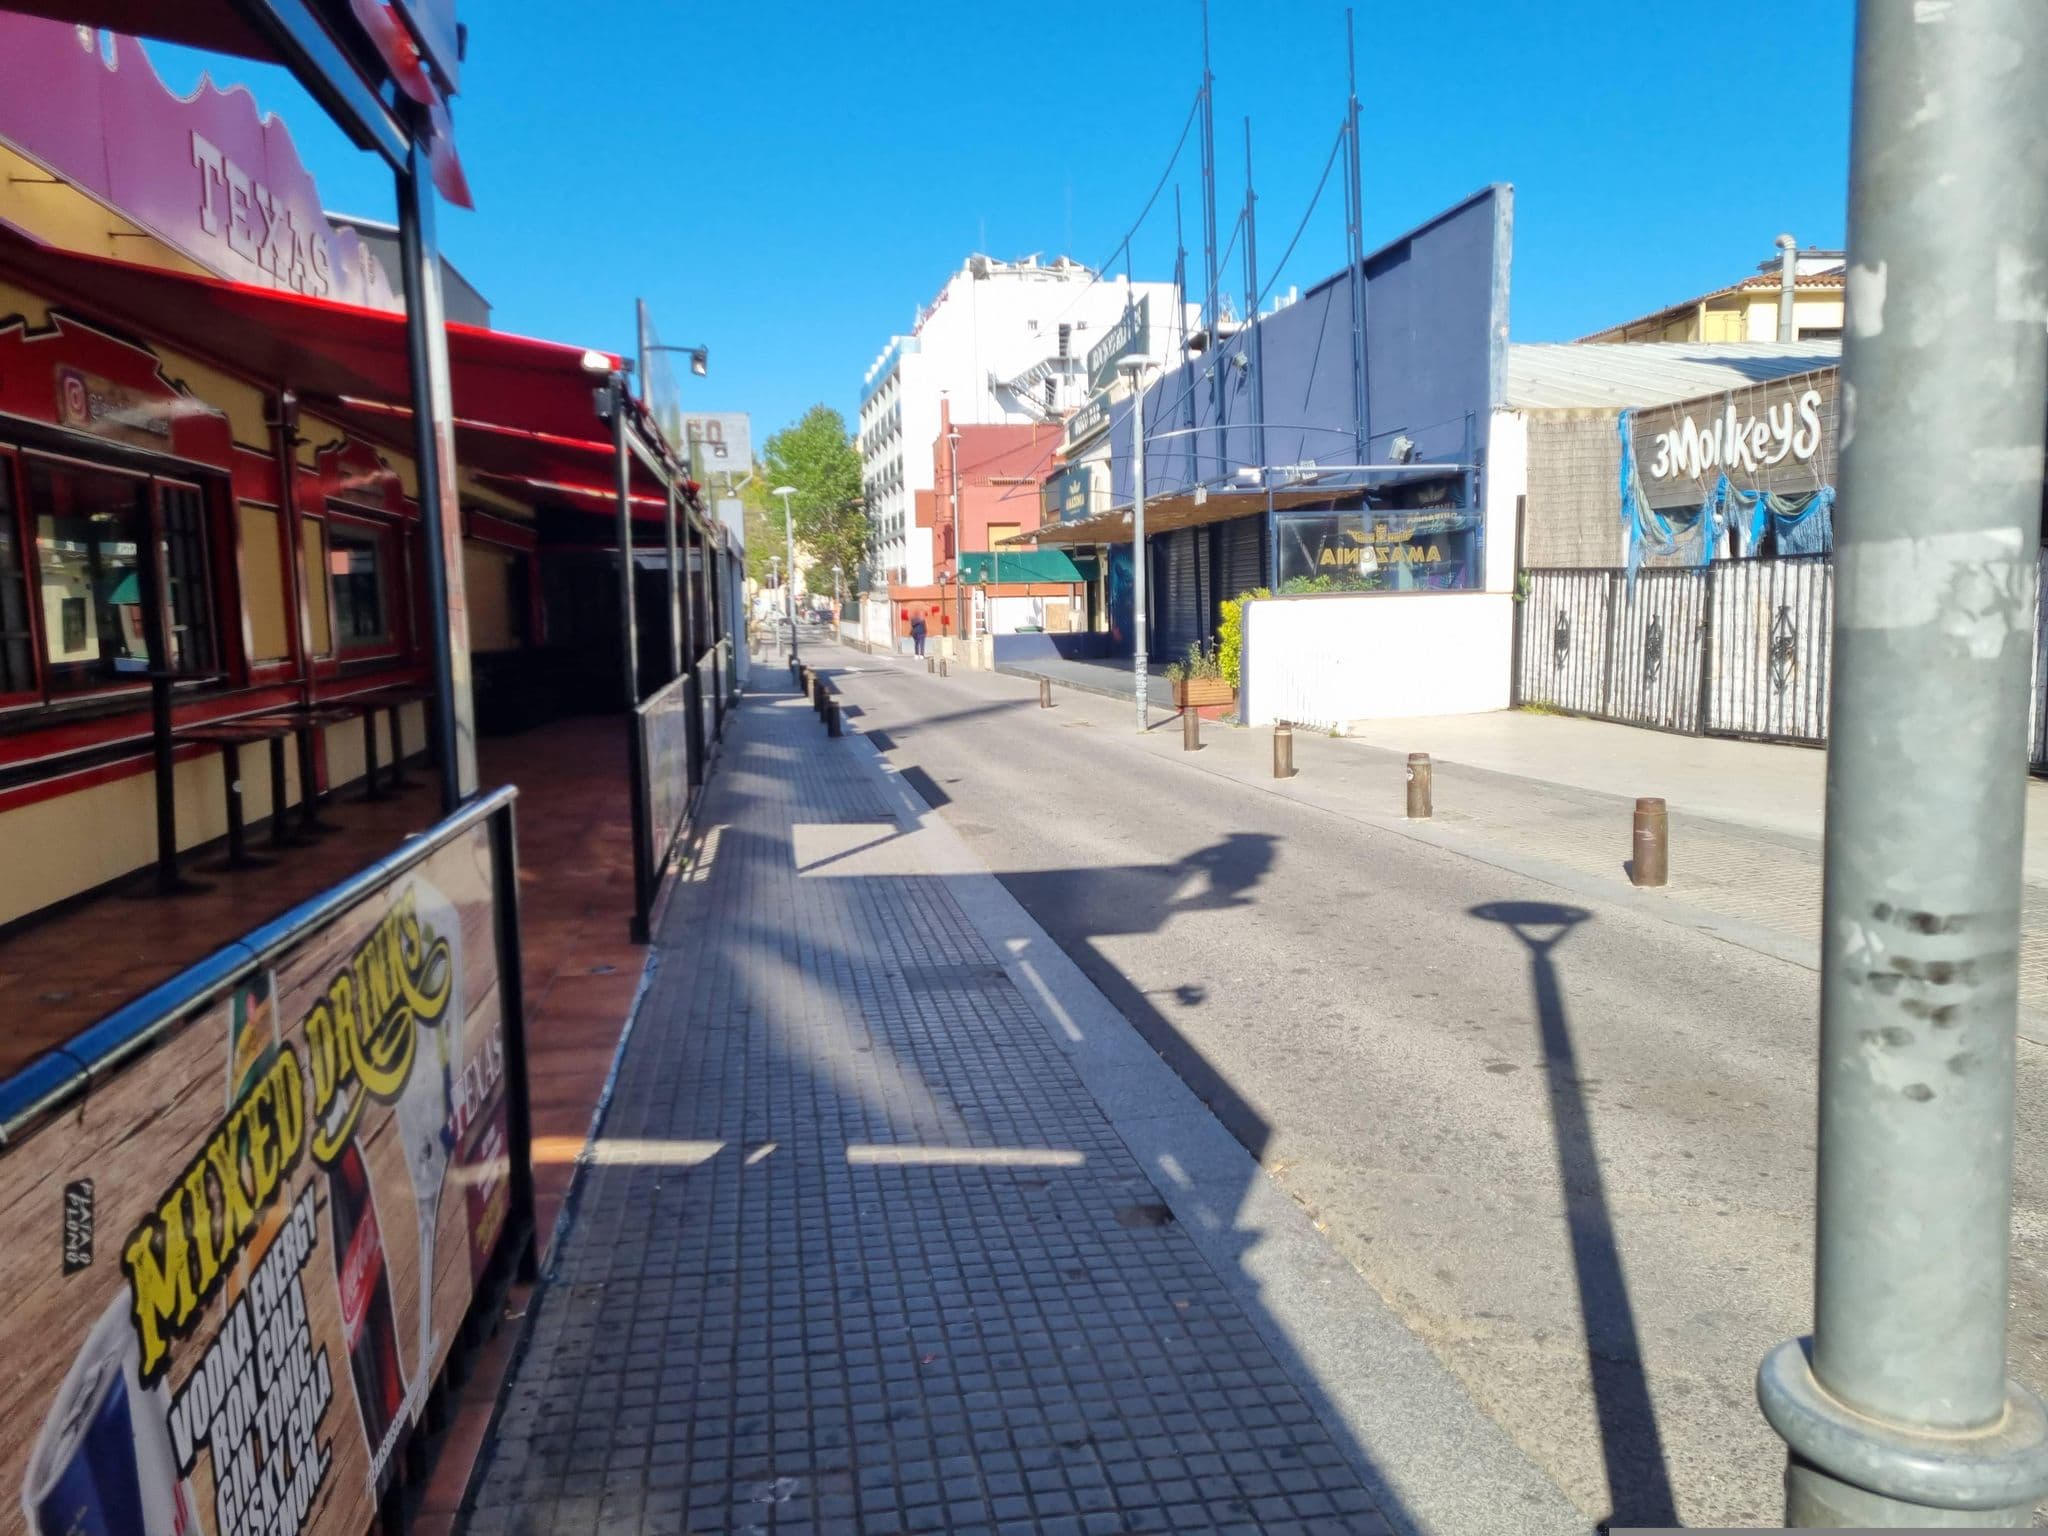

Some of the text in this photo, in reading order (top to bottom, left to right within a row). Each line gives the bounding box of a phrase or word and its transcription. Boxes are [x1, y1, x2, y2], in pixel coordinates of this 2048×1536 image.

[190, 129, 329, 297] TEXAS
[126, 1050, 304, 1377] MIXED
[306, 886, 450, 1160] DRINKS
[170, 1184, 317, 1469] VODKA ENERGY
[211, 1282, 306, 1482] RON COLA
[288, 1350, 332, 1468] COLA
[217, 1326, 313, 1536] GIN TONIC
